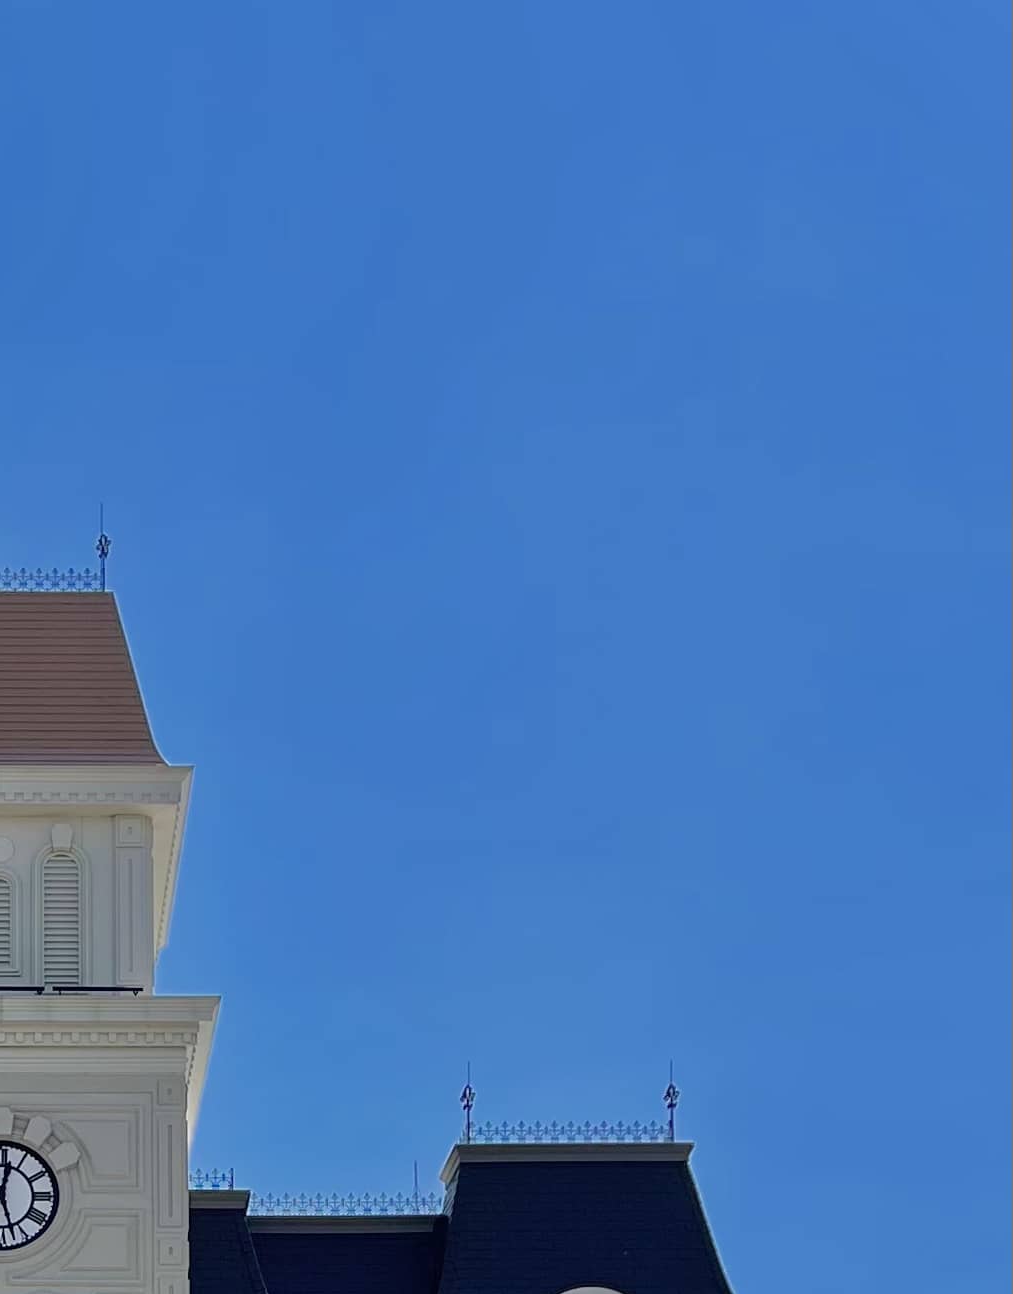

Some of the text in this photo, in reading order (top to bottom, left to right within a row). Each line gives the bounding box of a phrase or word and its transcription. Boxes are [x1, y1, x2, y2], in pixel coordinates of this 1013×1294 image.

[17, 1151, 28, 1169] I
[28, 1169, 47, 1182] II
[33, 1190, 53, 1202] III
